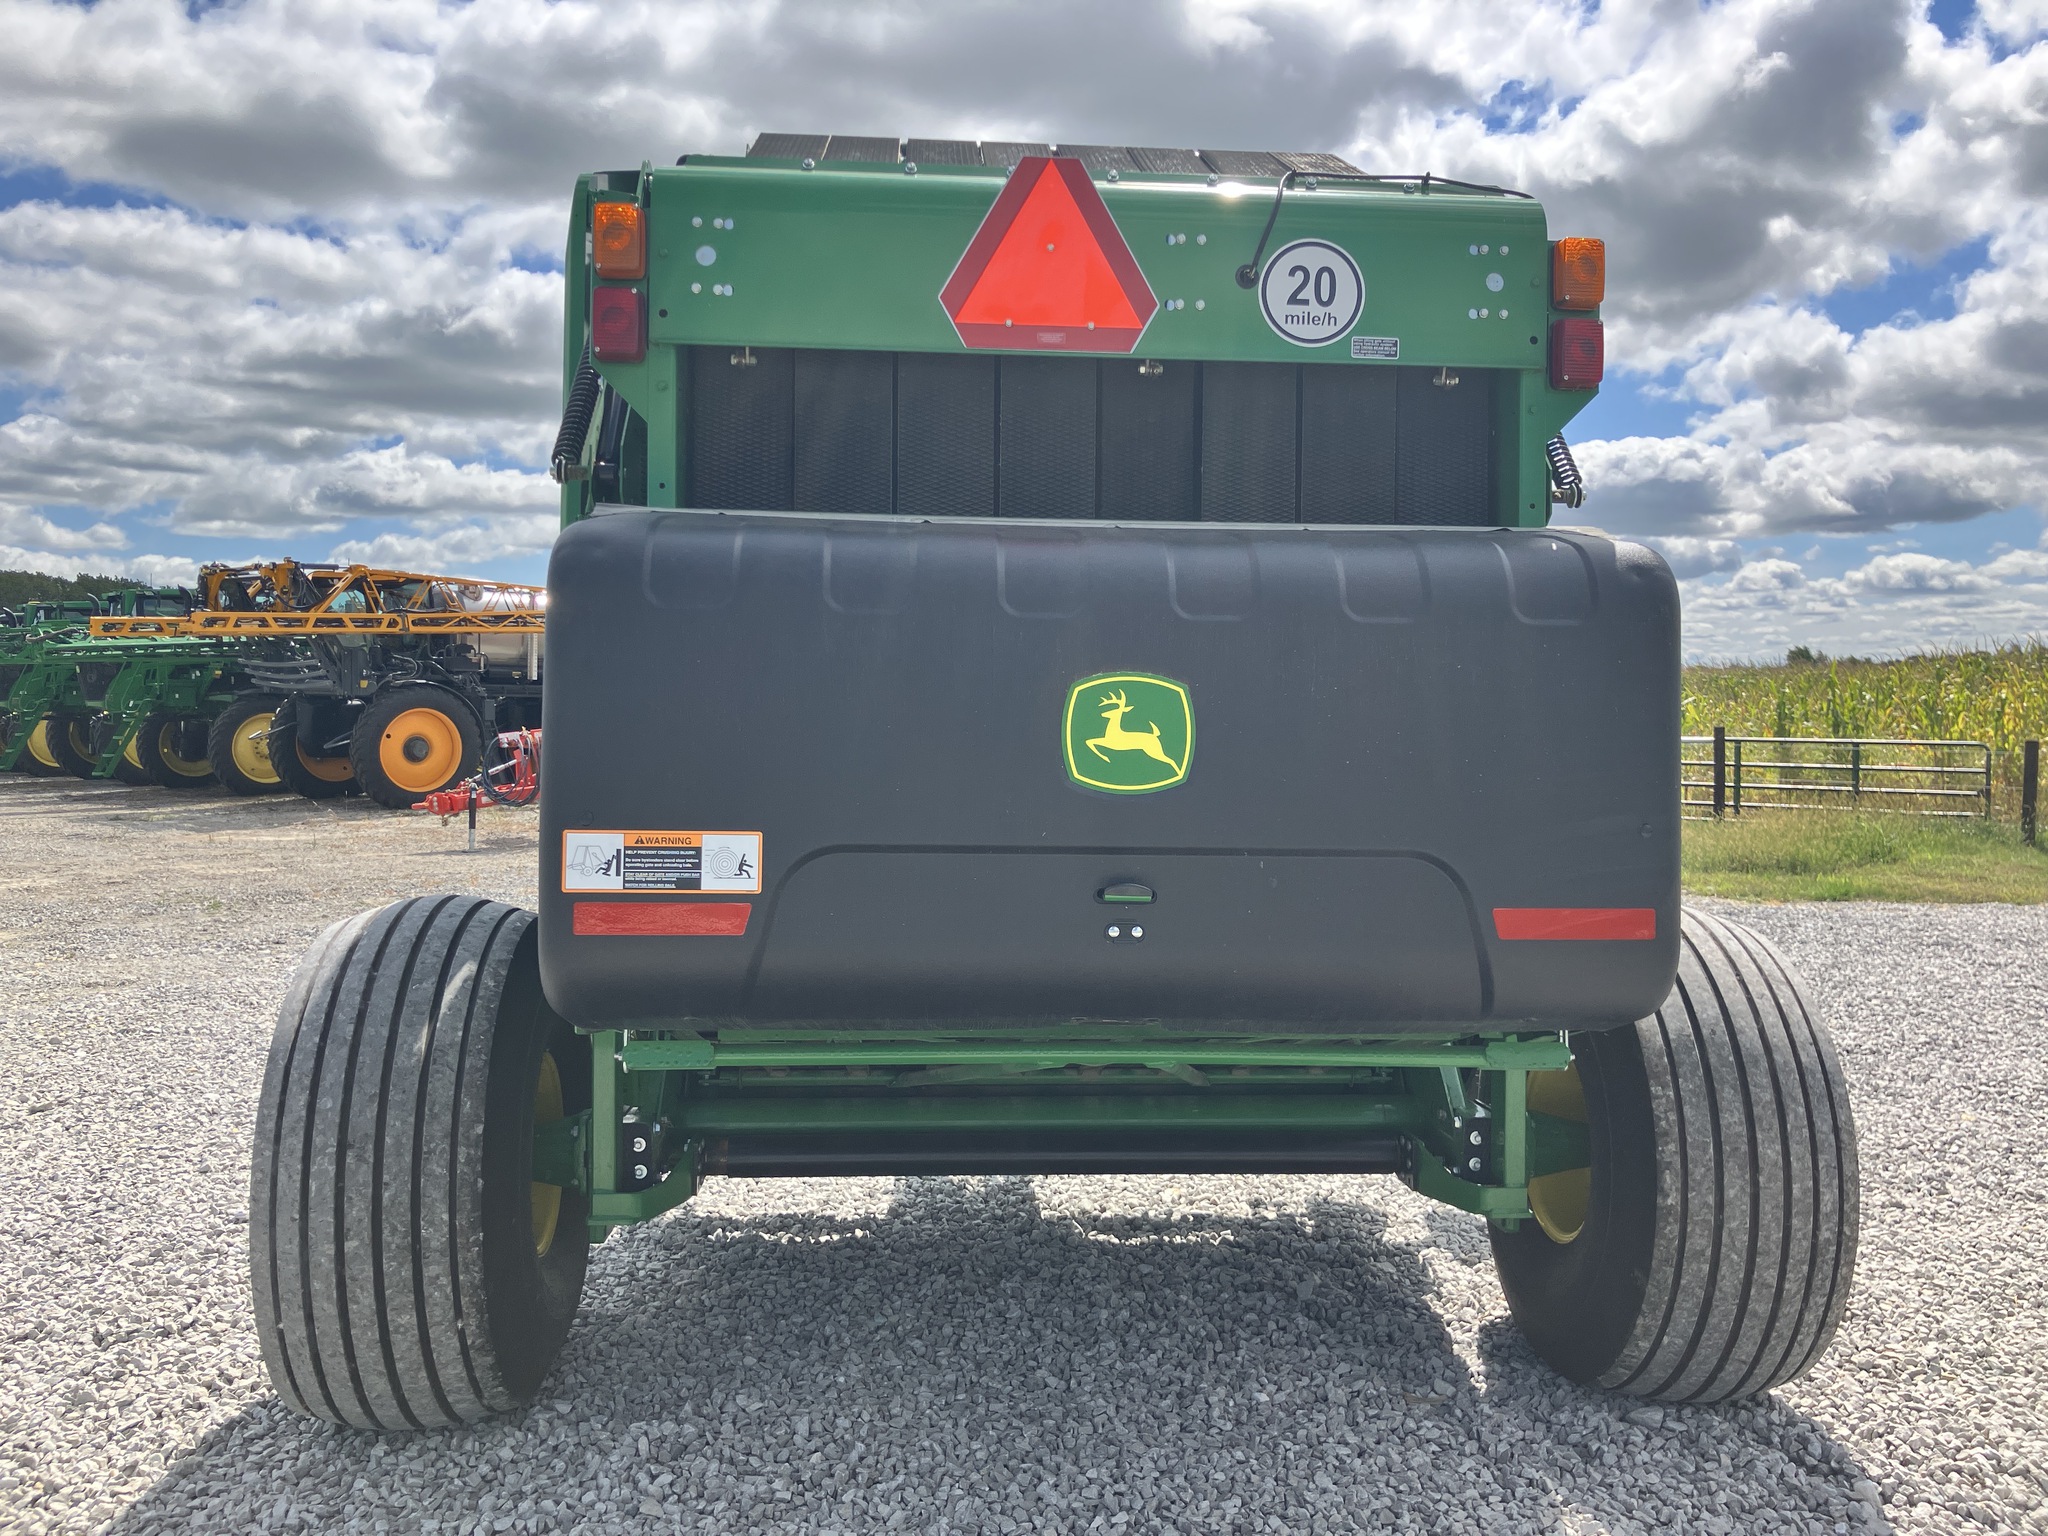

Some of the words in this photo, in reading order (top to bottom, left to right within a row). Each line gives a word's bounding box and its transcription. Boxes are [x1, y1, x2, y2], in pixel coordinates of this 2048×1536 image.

[1286, 265, 1337, 307] 20
[1285, 311, 1337, 326] mile/h
[645, 836, 691, 845] WARNING
